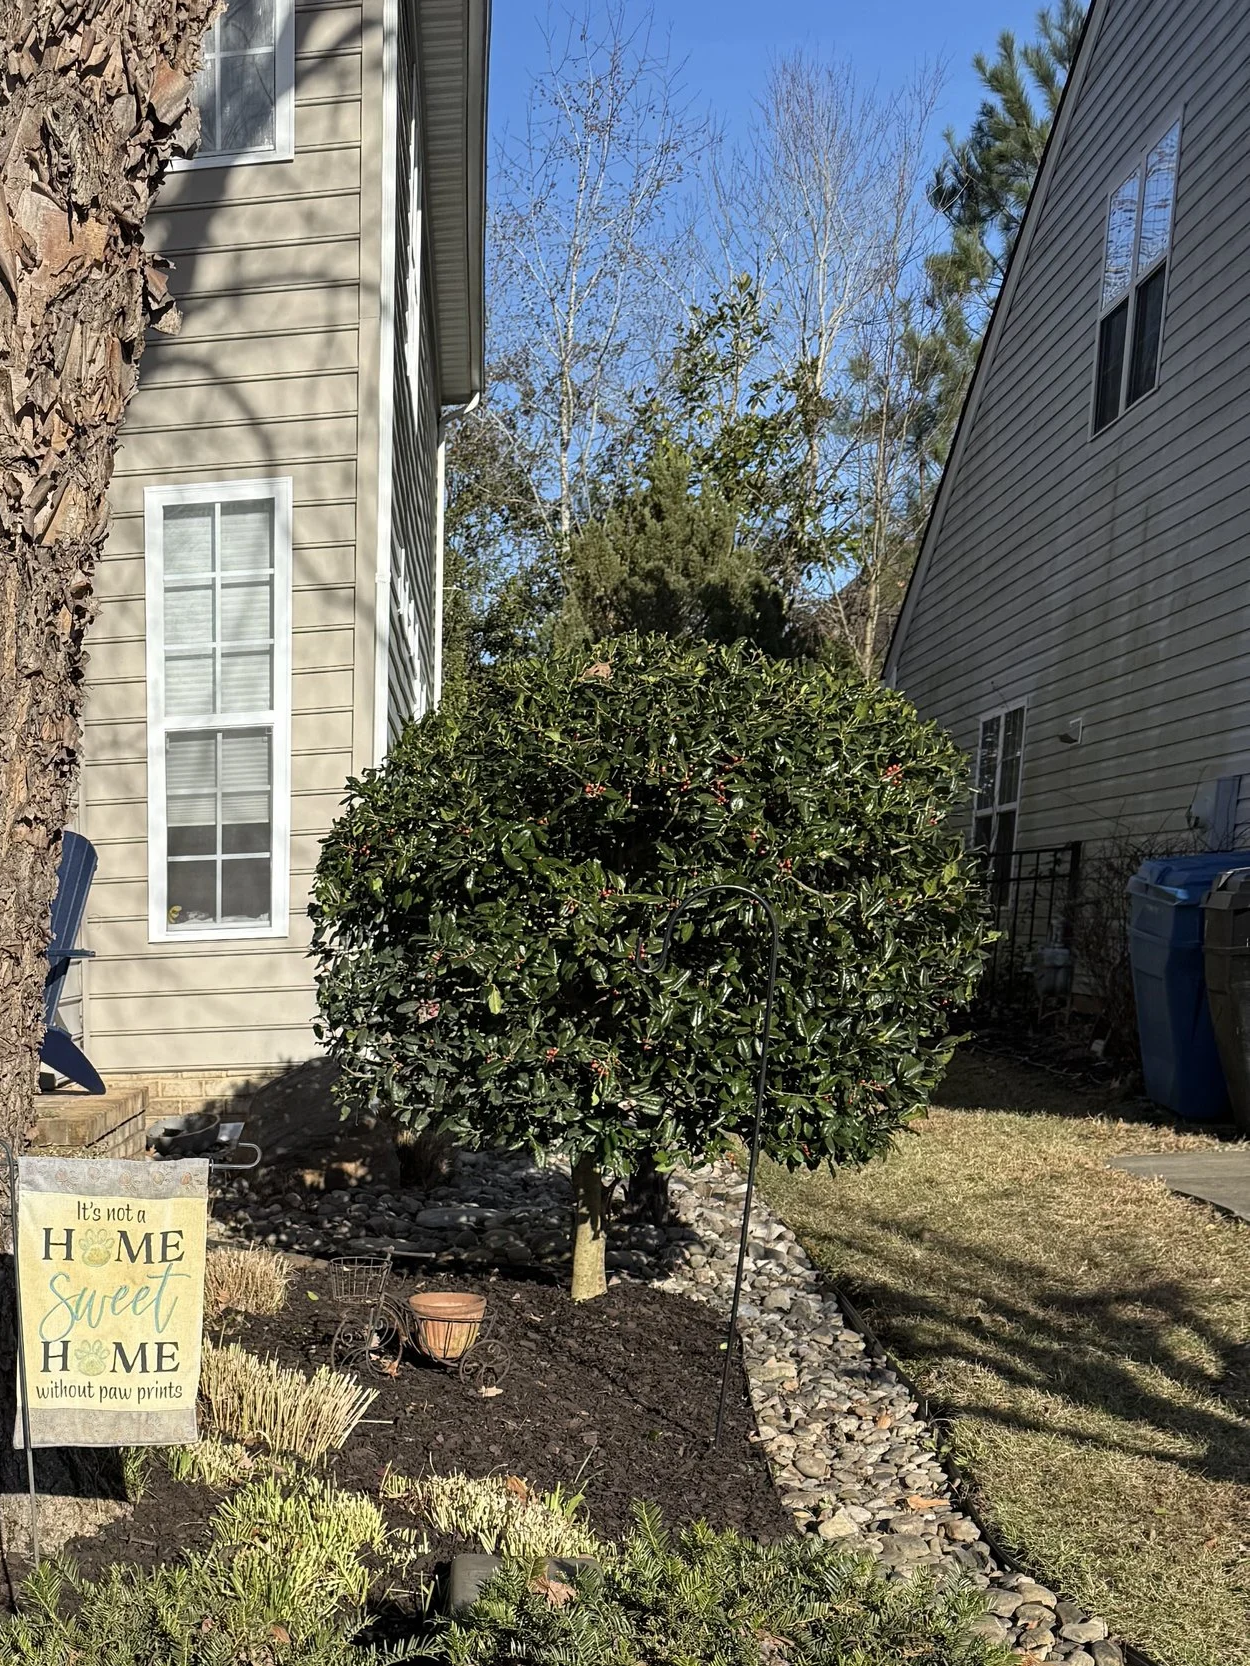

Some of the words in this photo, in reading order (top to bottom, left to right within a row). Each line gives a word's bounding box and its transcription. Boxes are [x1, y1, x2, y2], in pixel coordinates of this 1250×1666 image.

[77, 1200, 101, 1222] It's
[107, 1204, 134, 1222] not
[137, 1209, 146, 1224] a
[36, 1379, 95, 1401] without
[99, 1382, 132, 1403] paw
[137, 1381, 183, 1406] prints
